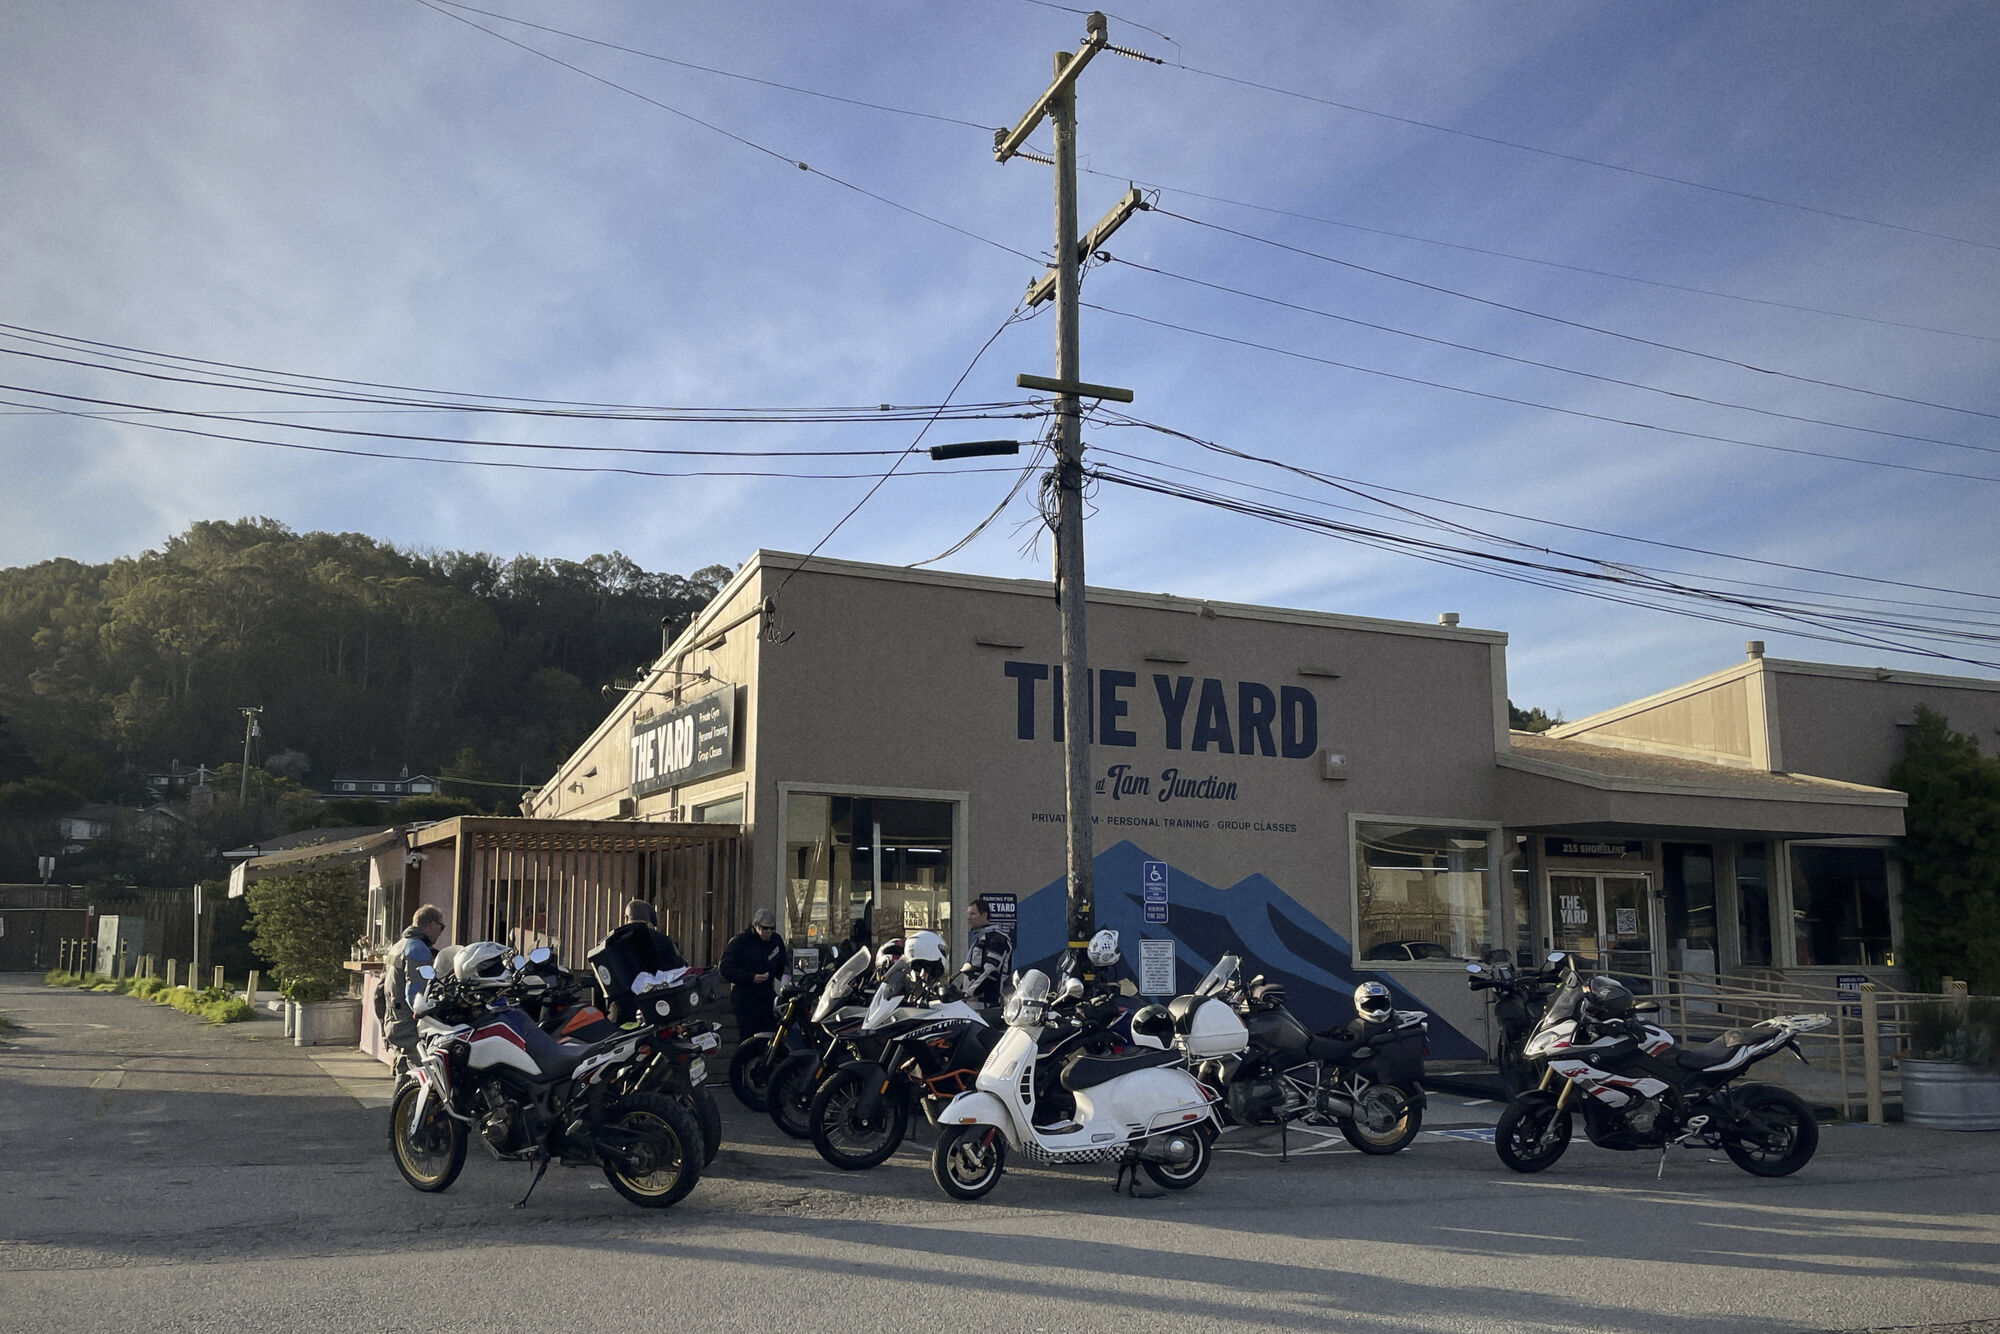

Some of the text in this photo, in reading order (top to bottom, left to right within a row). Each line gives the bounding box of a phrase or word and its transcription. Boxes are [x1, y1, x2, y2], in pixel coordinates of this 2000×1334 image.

[1153, 674, 1318, 759] YARD
[631, 714, 694, 784] THE YARD
[1095, 764, 1238, 803] at Tam Junction
[1032, 813, 1066, 823] PRIVAT
[1107, 816, 1160, 827] PERSONAL
[1163, 818, 1209, 829] TRAINING
[1217, 820, 1297, 833] GROUP CLASSES
[1562, 843, 1626, 854] 215 SHORELINE
[996, 903, 1015, 912] YARD
[1559, 895, 1580, 909] THE
[905, 918, 923, 926] YARD
[1559, 909, 1588, 924] YARD
